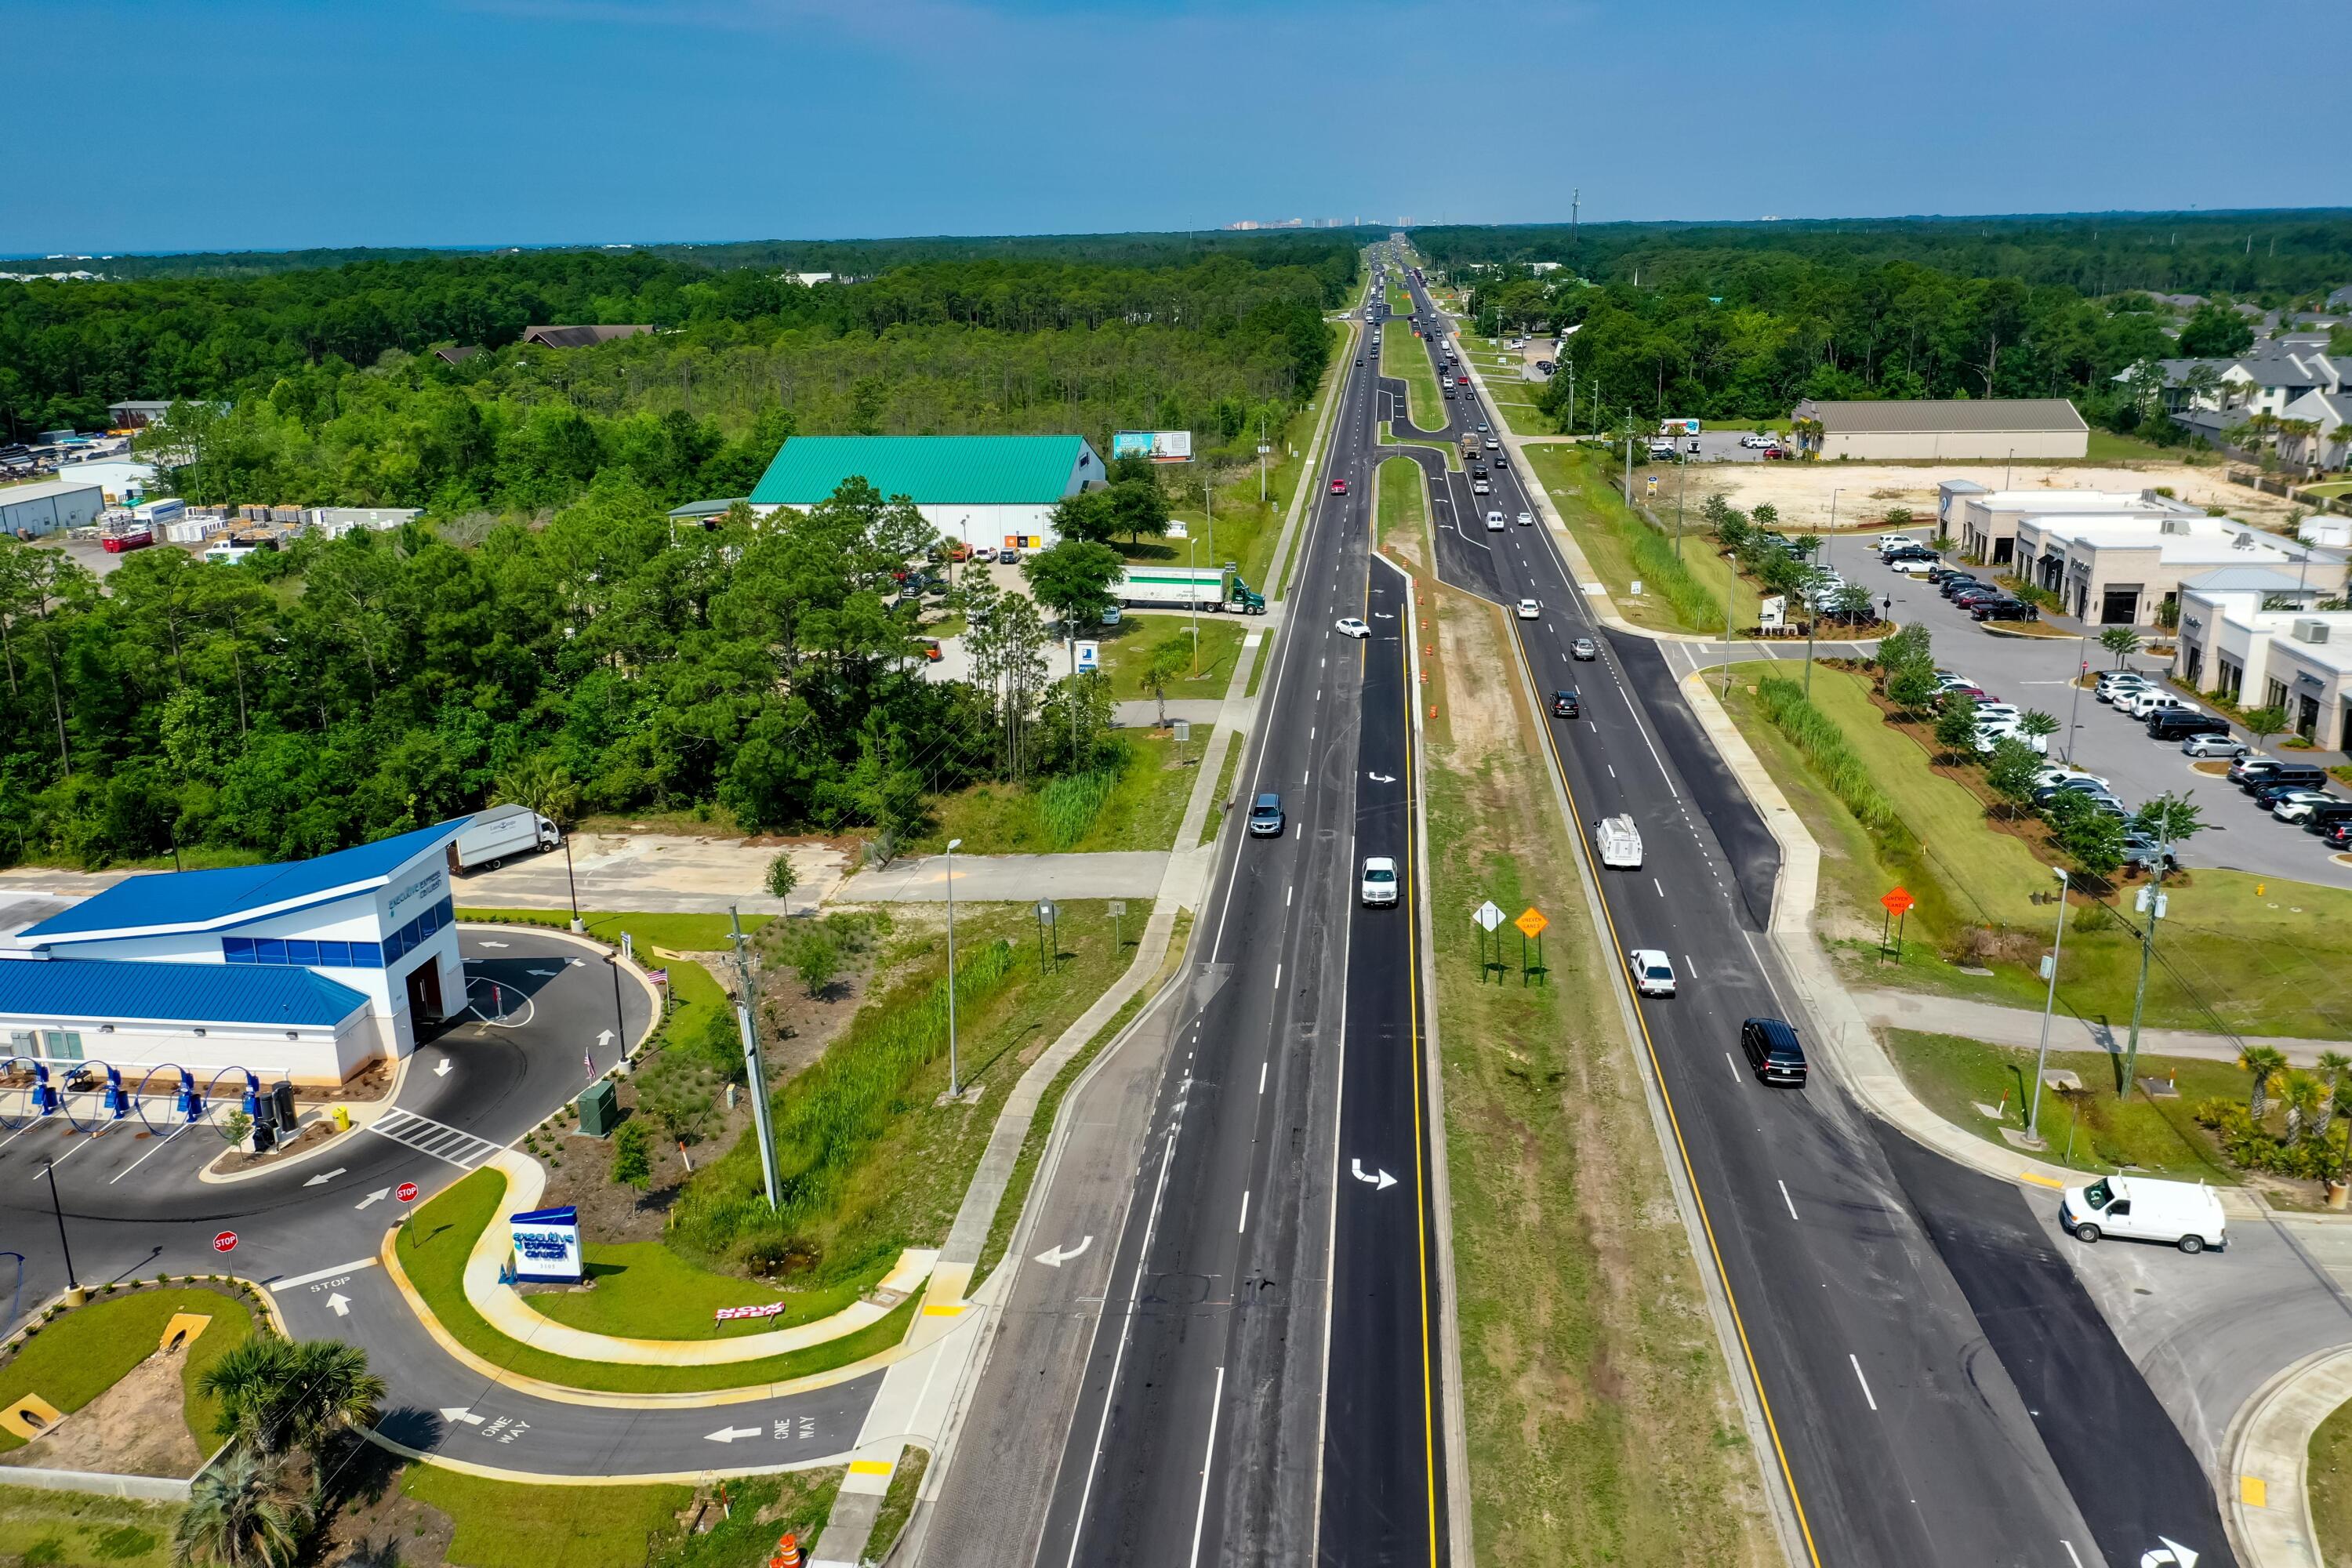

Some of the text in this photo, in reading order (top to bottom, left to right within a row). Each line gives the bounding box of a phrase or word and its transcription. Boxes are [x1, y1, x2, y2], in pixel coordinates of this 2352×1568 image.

[397, 1187, 416, 1197] STOP
[215, 1236, 236, 1247] STOP
[310, 1276, 351, 1293] STOP
[716, 1306, 783, 1319] OPEN
[717, 1301, 783, 1313] NOW
[481, 1416, 514, 1436] ONE
[496, 1421, 531, 1443] WAY
[774, 1418, 790, 1439] ONE
[799, 1416, 815, 1439] WAY
